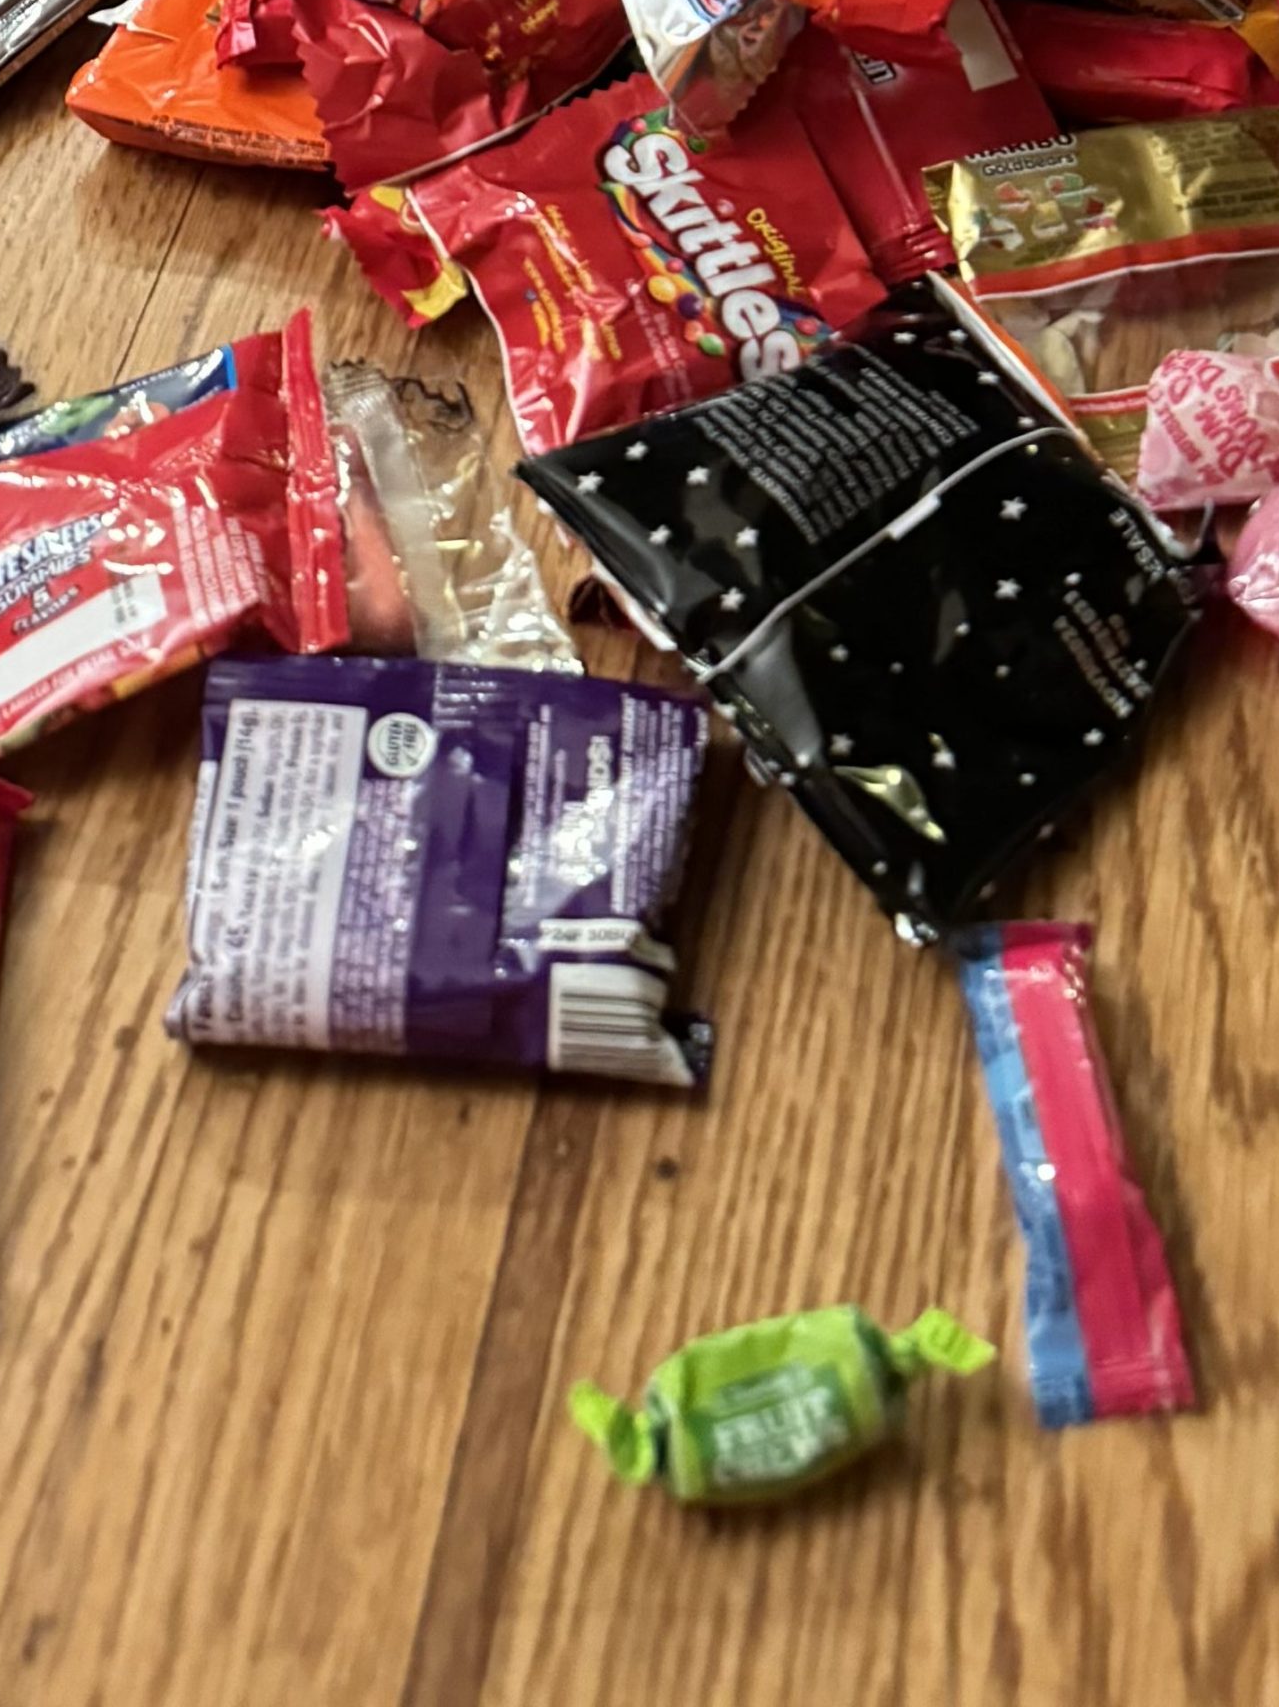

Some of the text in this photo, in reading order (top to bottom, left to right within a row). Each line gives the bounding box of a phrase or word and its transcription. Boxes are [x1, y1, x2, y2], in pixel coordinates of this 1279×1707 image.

[982, 152, 1077, 179] Goldbears
[604, 132, 802, 383] Skittles
[13, 586, 81, 635] FLAVORS
[30, 586, 50, 606] 5
[384, 719, 401, 768] GLUTEN
